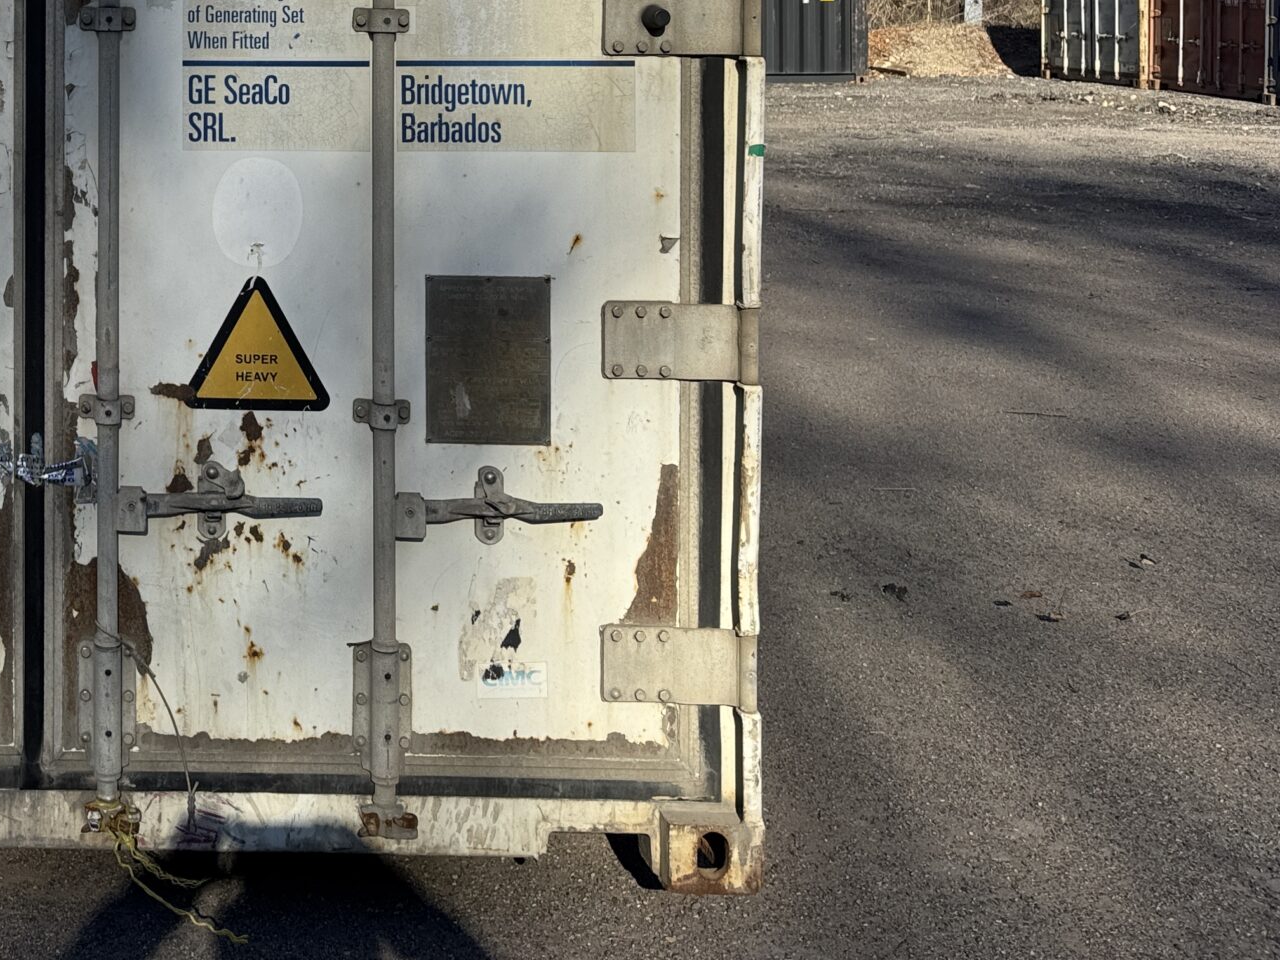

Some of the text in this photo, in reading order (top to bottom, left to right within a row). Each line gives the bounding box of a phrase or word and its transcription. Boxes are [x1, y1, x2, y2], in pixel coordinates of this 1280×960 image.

[187, 5, 305, 27] of Generating Set
[188, 31, 270, 49] When Fitted
[188, 74, 291, 105] GE SeaCo
[400, 74, 532, 112] Bridgetown,
[188, 112, 237, 143] SRL.
[401, 112, 502, 143] Barbados
[235, 353, 278, 365] SUPER
[235, 371, 278, 383] HEAVY
